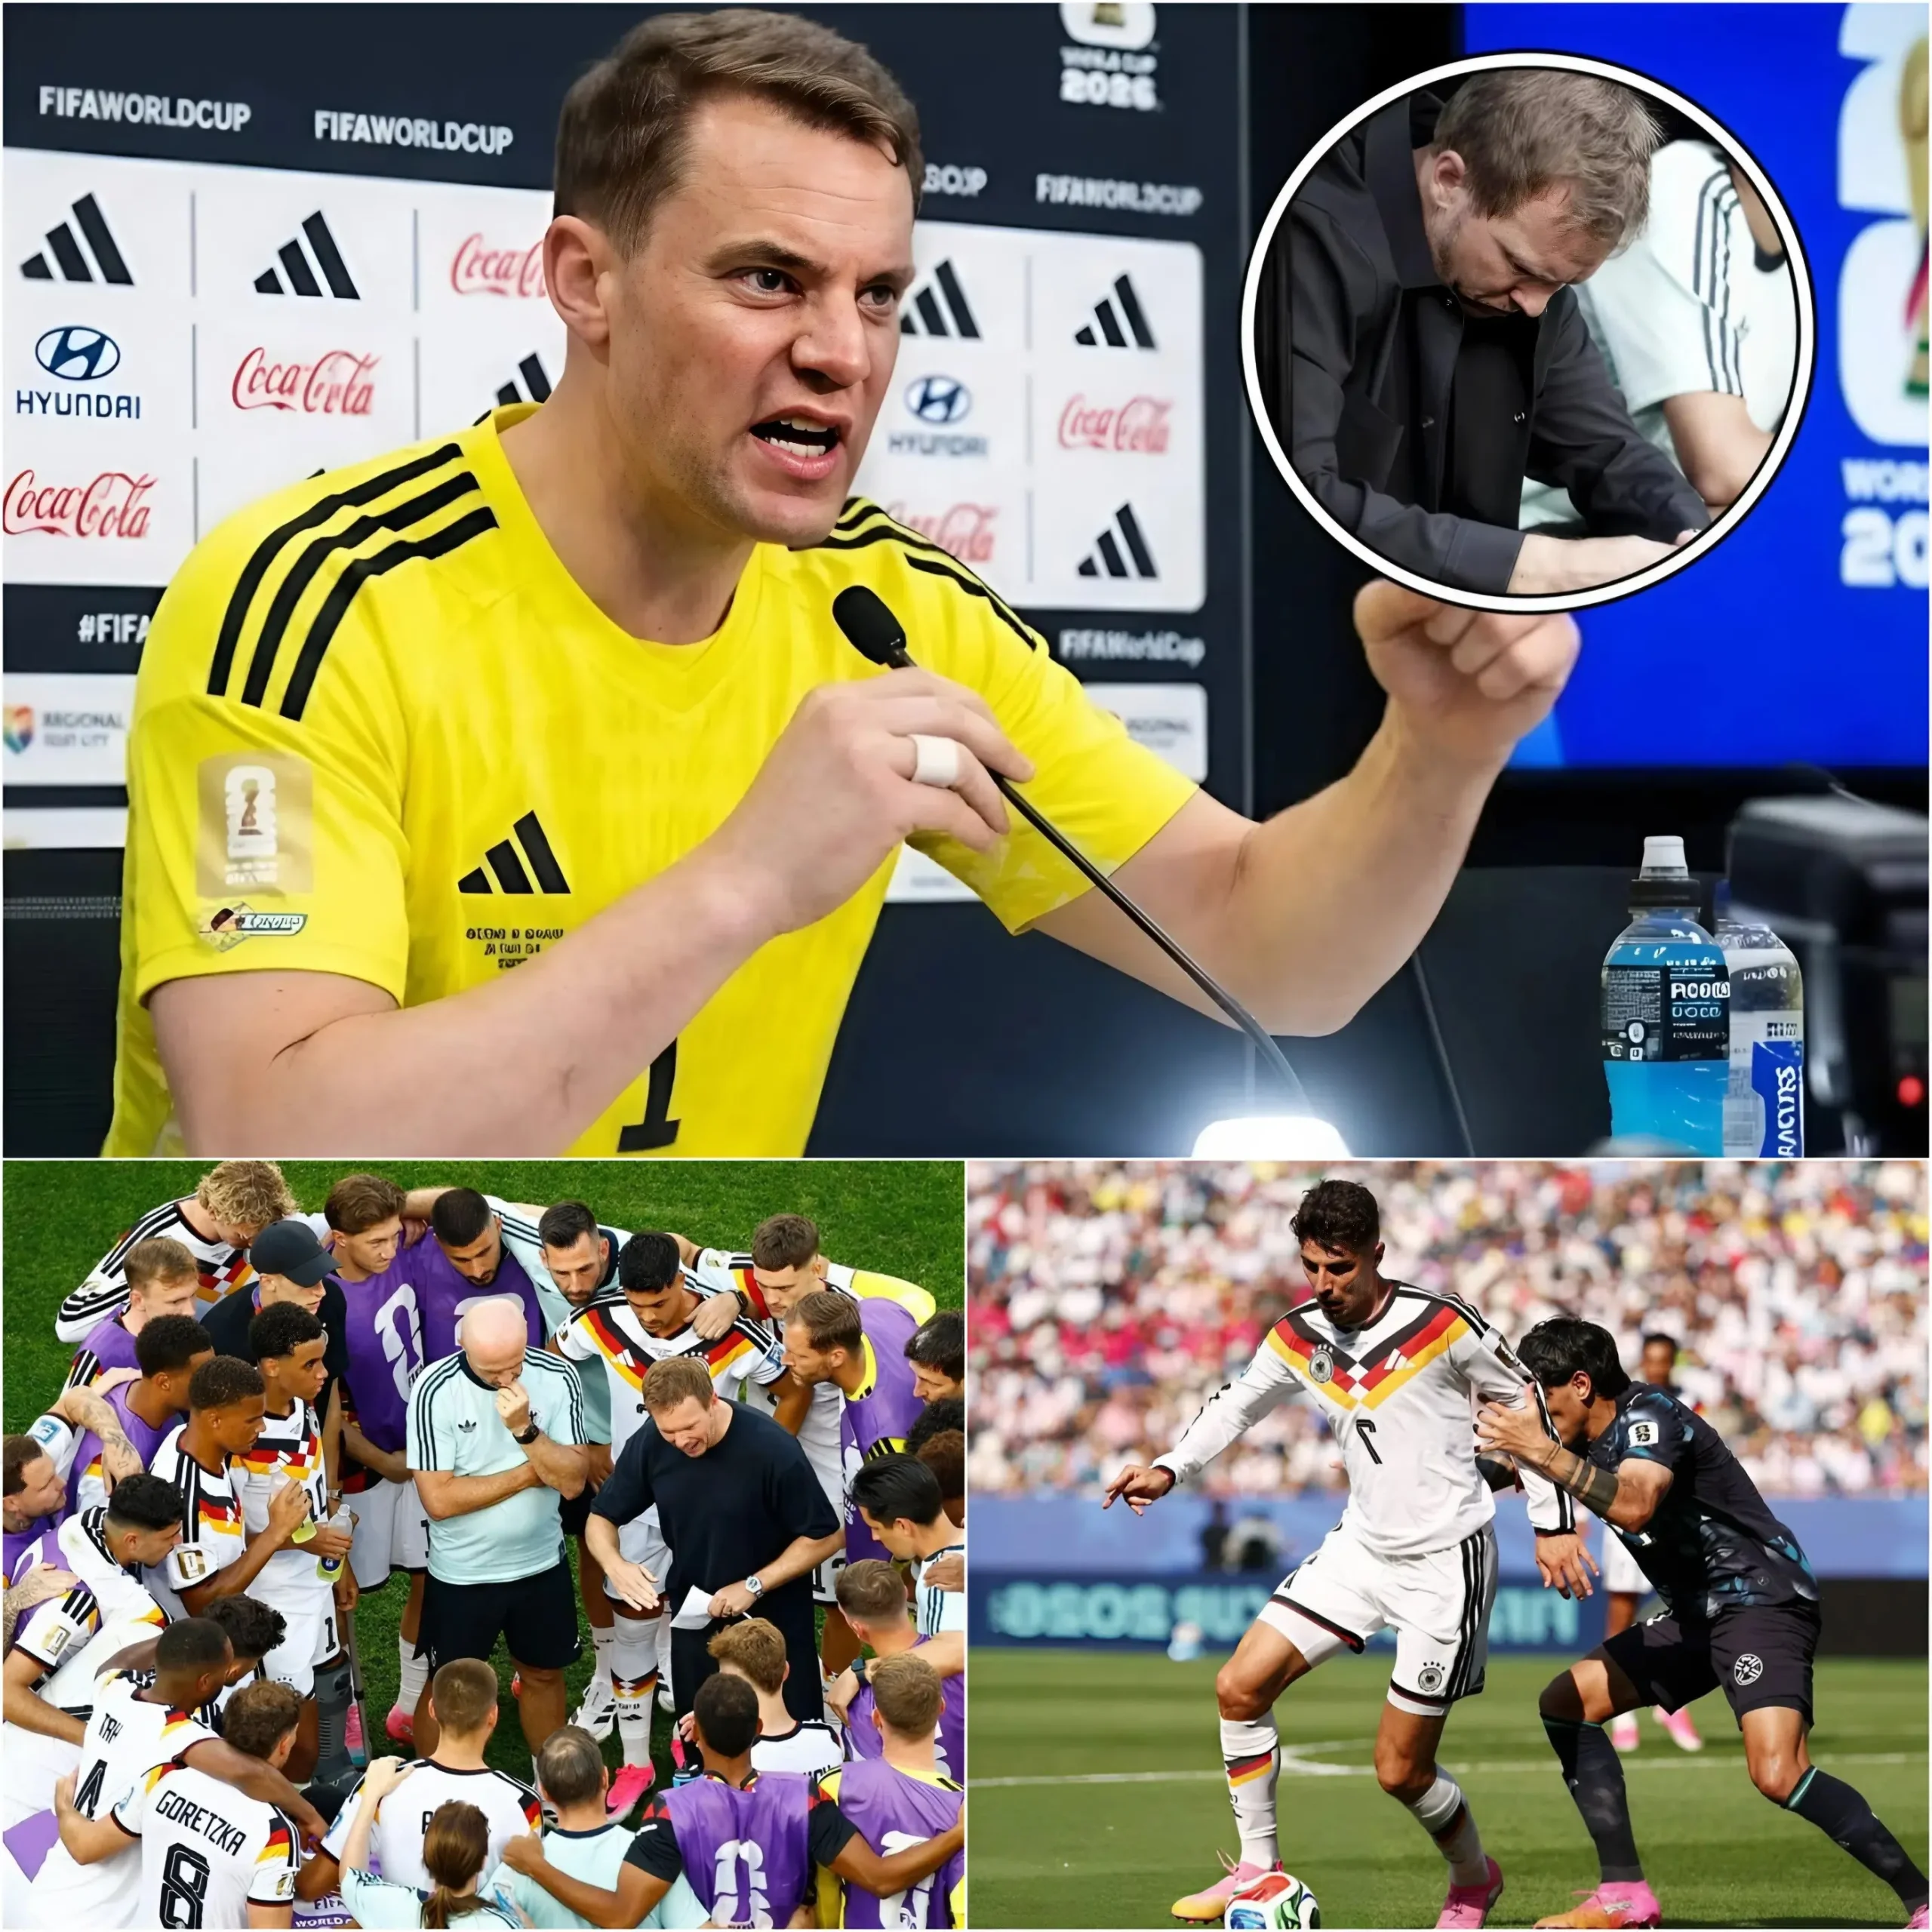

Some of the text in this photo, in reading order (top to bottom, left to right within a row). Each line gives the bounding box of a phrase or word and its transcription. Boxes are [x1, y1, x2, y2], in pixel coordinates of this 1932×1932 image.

[39, 85, 251, 131] FIFAWORLDCUP
[315, 110, 514, 155] FIFAWORLDCUP
[16, 390, 141, 419] HYUNDAI
[325, 1617, 337, 1654] 1
[155, 1789, 247, 1857] GORETZKA
[159, 1842, 211, 1929] 8
[295, 1918, 343, 1927] WORLD
